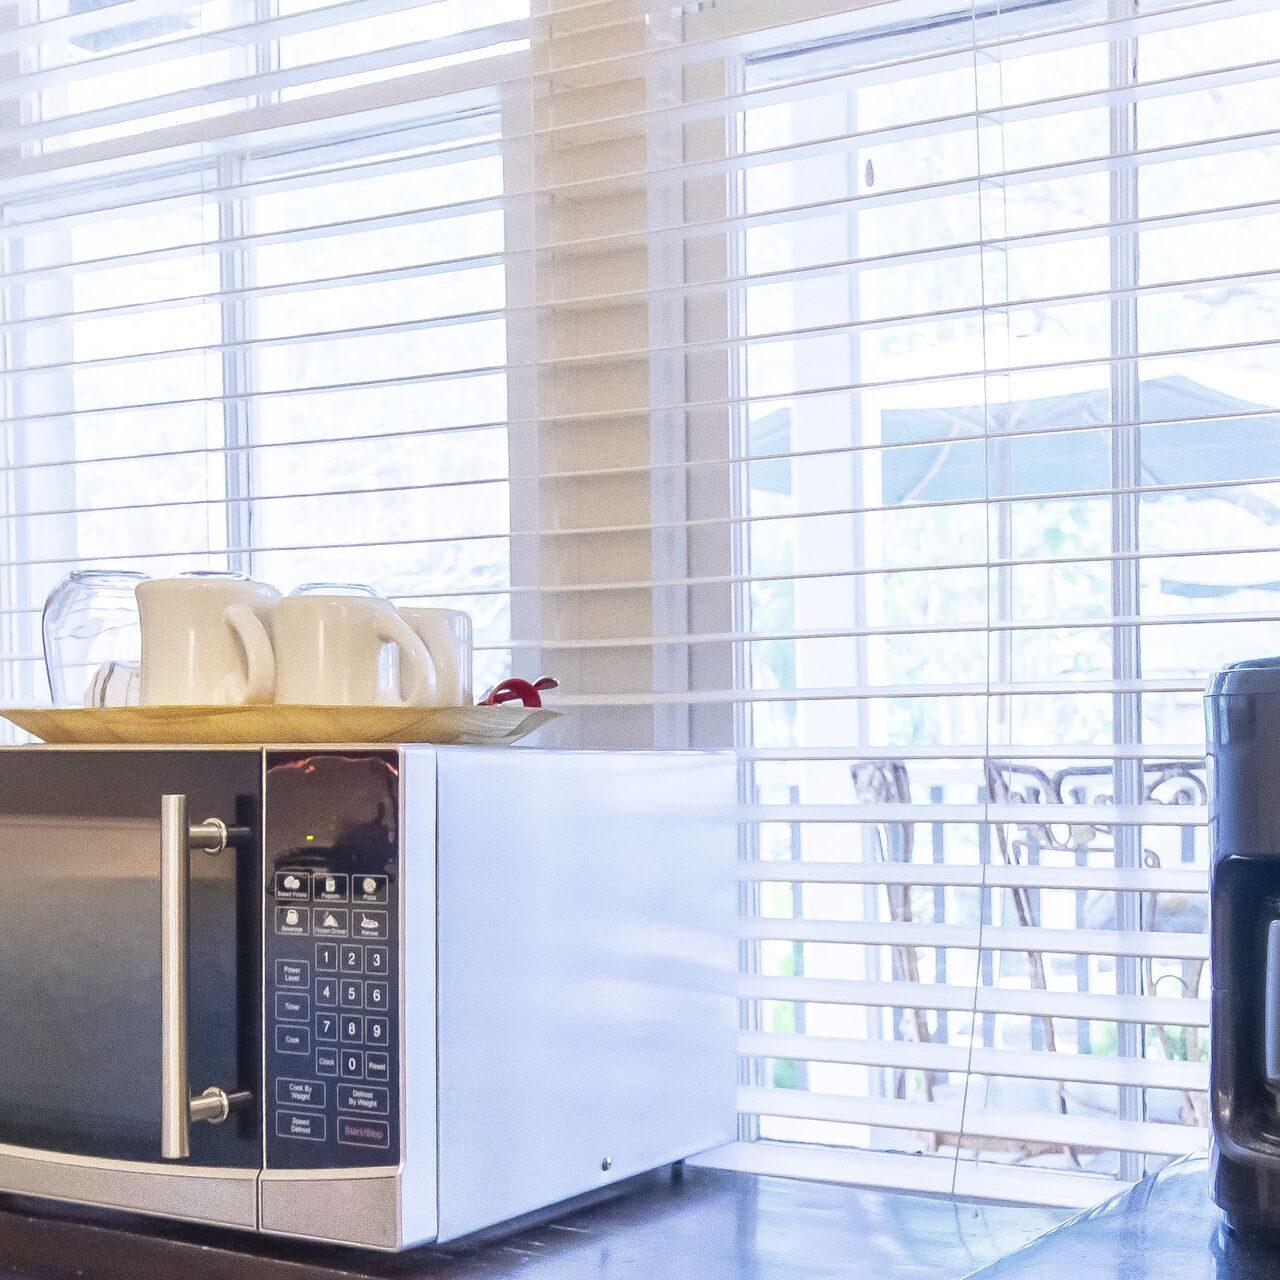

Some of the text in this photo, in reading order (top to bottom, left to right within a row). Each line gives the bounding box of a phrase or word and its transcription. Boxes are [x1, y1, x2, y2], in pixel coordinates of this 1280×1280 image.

[323, 952, 329, 963] 1
[348, 952, 356, 965] 2
[373, 953, 380, 966] 3
[283, 966, 301, 974] Power
[284, 974, 300, 982] Level
[323, 986, 330, 998] 4
[348, 987, 355, 999] 5
[373, 989, 381, 1001] 6
[285, 1002, 300, 1011] Timer
[323, 1020, 330, 1033] 7
[348, 1022, 356, 1035] 8
[373, 1025, 381, 1038] 9
[285, 1035, 300, 1044] Cook
[318, 1057, 335, 1066] Clock
[348, 1057, 356, 1070] 0
[368, 1062, 386, 1071] Reset
[289, 1083, 313, 1093] Cook By
[291, 1092, 311, 1101] Weight
[352, 1090, 374, 1099] Defrost
[348, 1097, 378, 1108] By Weight
[292, 1117, 310, 1126] Speed
[290, 1125, 311, 1134] Defrost
[344, 1125, 383, 1140] Start/Stop
